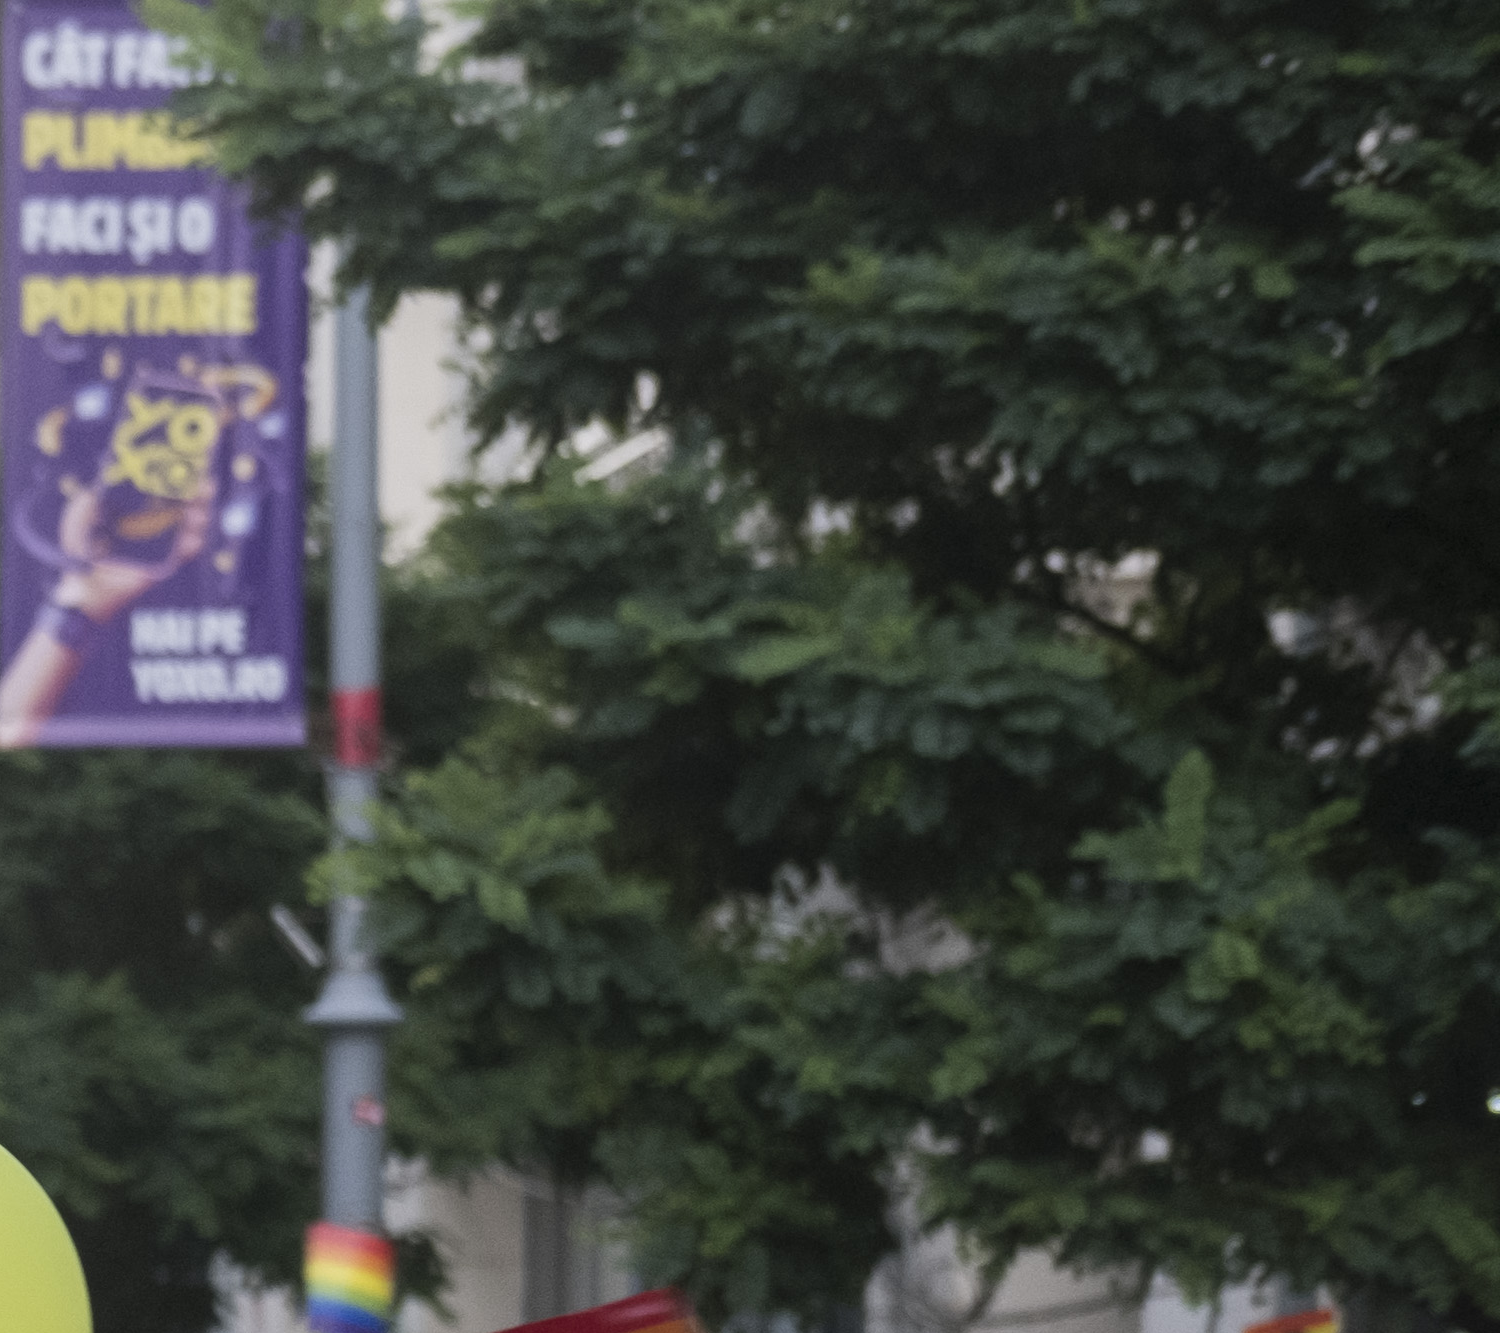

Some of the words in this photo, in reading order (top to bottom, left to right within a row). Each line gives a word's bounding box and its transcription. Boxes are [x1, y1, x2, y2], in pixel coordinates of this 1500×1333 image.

[21, 20, 106, 88] CÂT
[20, 198, 119, 253] FACI
[176, 198, 216, 254] O
[22, 274, 257, 335] PORTARE
